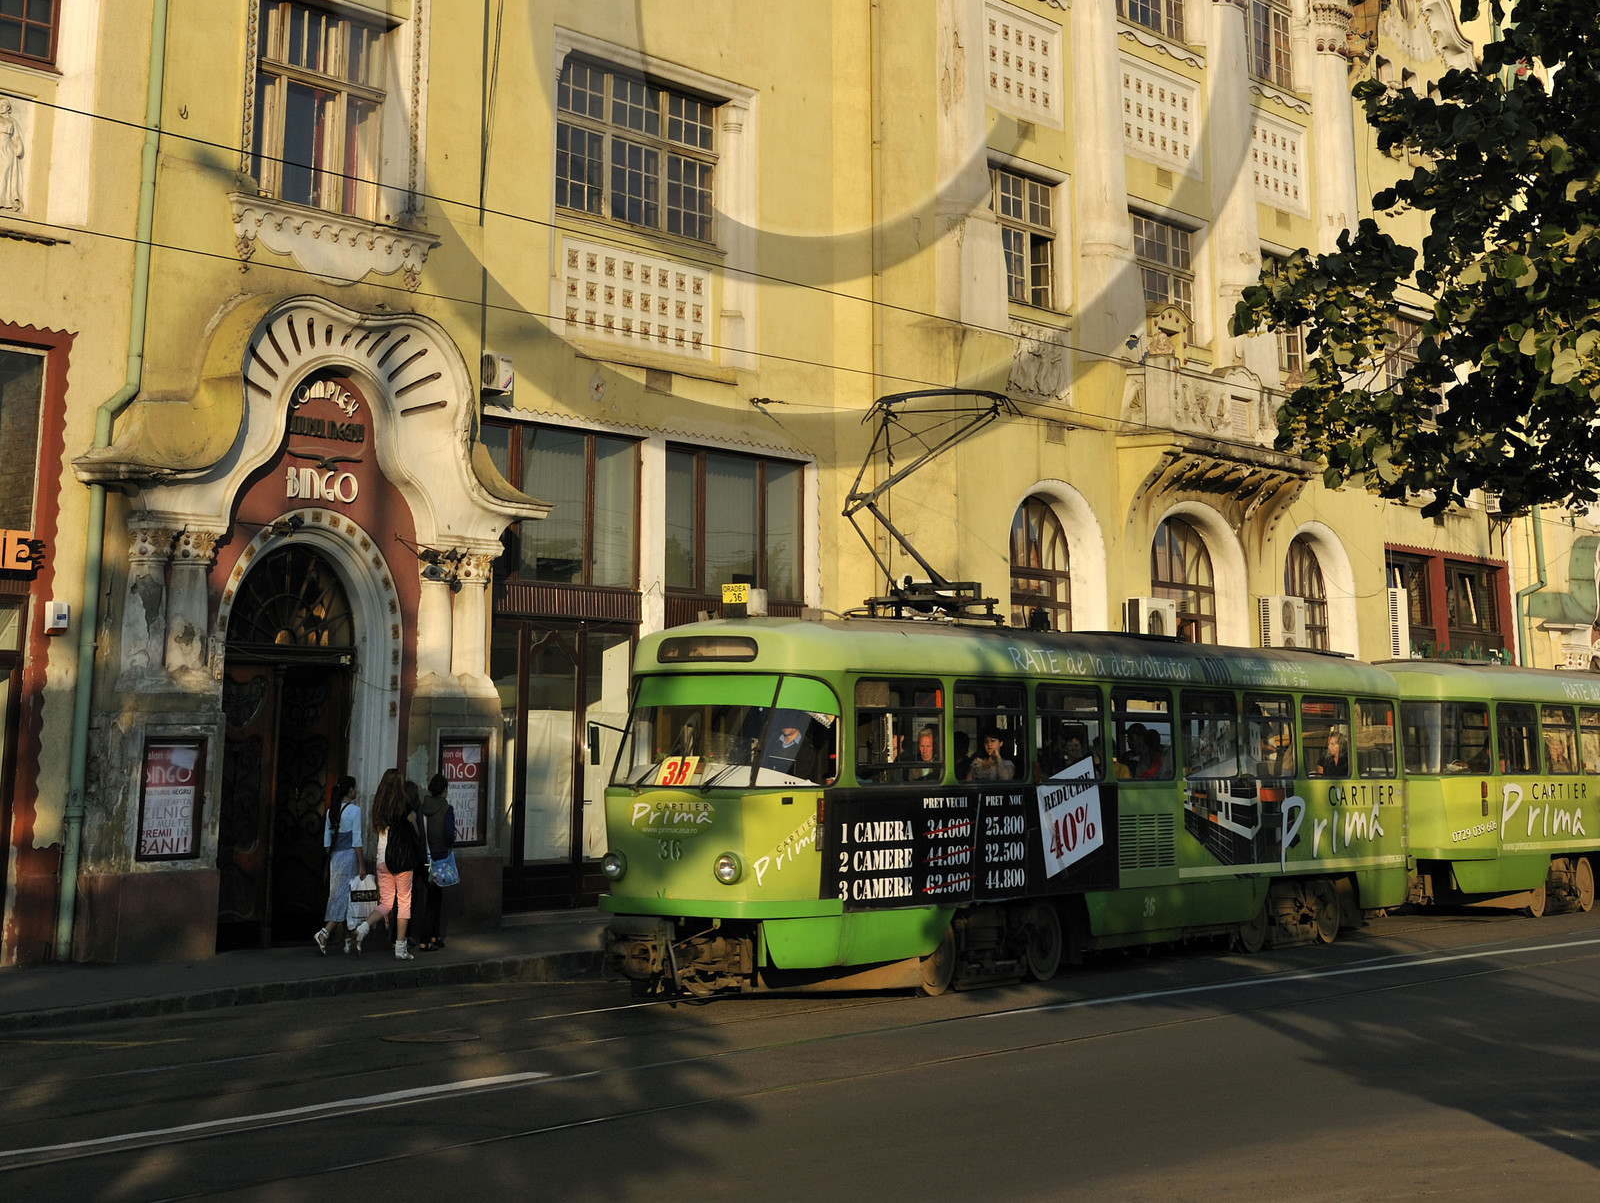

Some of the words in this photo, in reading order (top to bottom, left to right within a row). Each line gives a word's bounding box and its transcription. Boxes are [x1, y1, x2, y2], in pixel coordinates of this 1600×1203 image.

[290, 380, 359, 417] COMPLEX
[327, 420, 365, 443] NEGRU
[285, 466, 359, 503] BINGO
[723, 585, 747, 593] ORADEA
[1008, 647, 1060, 674] RATE
[1066, 650, 1087, 675] de
[1088, 652, 1107, 676] la
[1111, 651, 1192, 680] dezvoltator
[442, 763, 477, 779] INGO
[985, 796, 1003, 807] PRET
[1008, 795, 1024, 806] NOU
[1328, 785, 1394, 806] CARTIER
[1532, 783, 1587, 799] CARTIER
[631, 802, 713, 826] Prima
[656, 802, 709, 811] CARTIER
[923, 797, 944, 809] PRET
[945, 797, 968, 808] VECHI
[1500, 783, 1586, 841] Prima
[642, 827, 699, 835] www.primacasa.ro
[841, 823, 848, 844] 1
[854, 820, 914, 844] CAMERA
[985, 815, 1024, 836] 25.800
[1049, 803, 1096, 859] 40%
[1281, 795, 1384, 874] Prima
[1452, 828, 1471, 843] 0729
[1472, 823, 1486, 837] 039
[658, 839, 681, 861] 36
[838, 851, 849, 873] 2
[853, 848, 913, 872] CAMERE
[985, 841, 1024, 863] 32.500
[838, 880, 848, 902] 3
[853, 876, 913, 901] CAMERE
[985, 868, 1025, 890] 44.800
